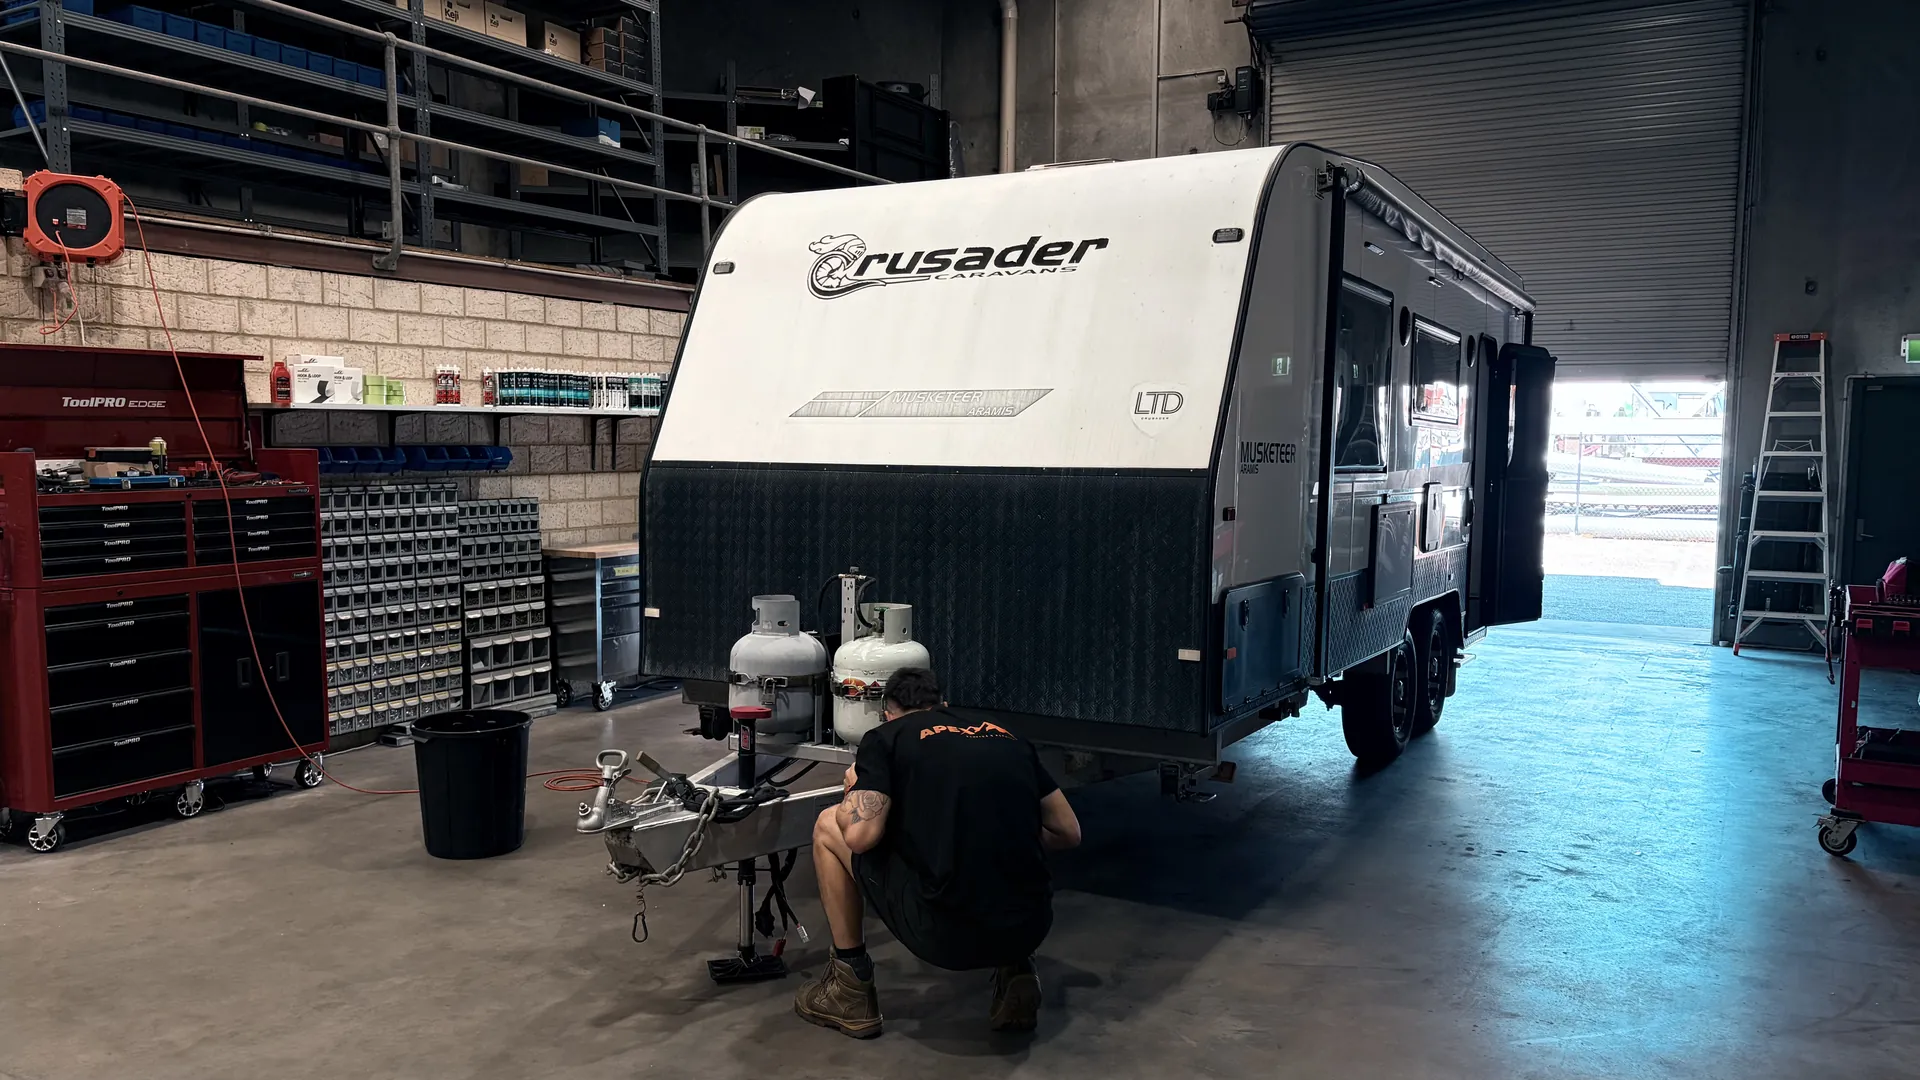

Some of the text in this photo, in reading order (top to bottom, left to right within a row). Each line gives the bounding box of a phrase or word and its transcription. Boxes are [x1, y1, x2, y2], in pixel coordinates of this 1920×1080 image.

[444, 8, 459, 22] Keji
[808, 235, 1109, 299] Crusader
[934, 265, 1077, 280] CARAVANS
[62, 397, 166, 408] ToolPRO EDGE
[892, 391, 984, 403] MUSKETEER
[1134, 391, 1183, 414] LTD
[967, 406, 1015, 416] ARAMIS
[1240, 441, 1296, 464] MUSKETEER
[1240, 464, 1259, 474] ARAMIS
[106, 600, 133, 608] ToolPRO
[108, 620, 135, 628] ToolPRO
[110, 659, 136, 667] ToolPRO
